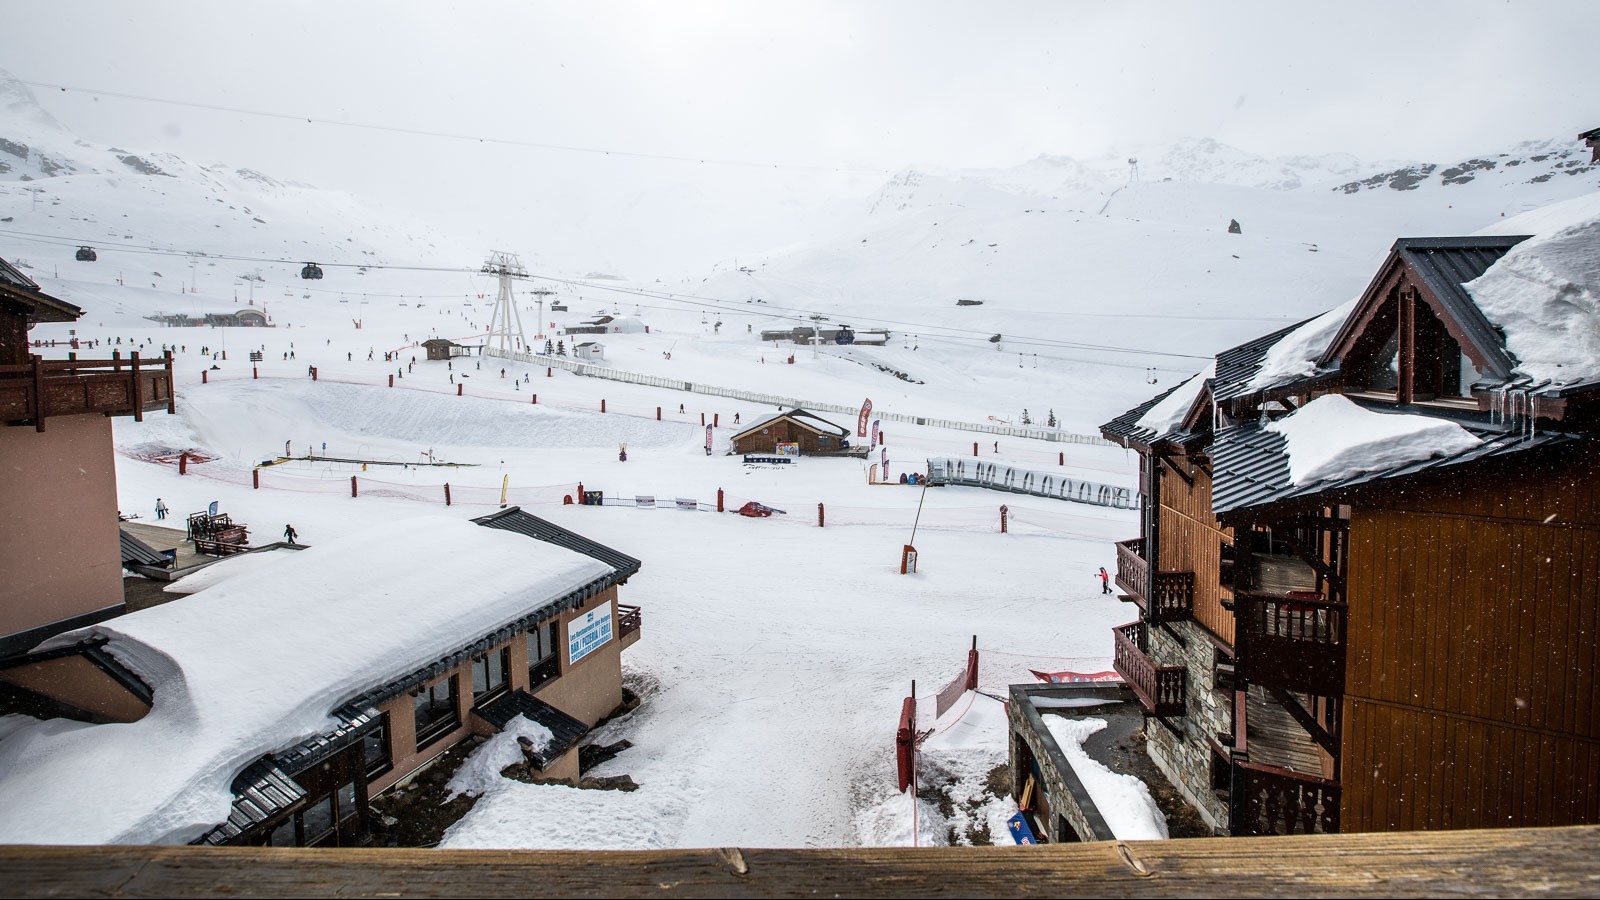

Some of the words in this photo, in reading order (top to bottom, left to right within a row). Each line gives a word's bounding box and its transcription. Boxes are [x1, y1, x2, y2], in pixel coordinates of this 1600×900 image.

[571, 641, 579, 654] BAR
[582, 630, 598, 647] PIZZERIA
[601, 622, 611, 636] GRILL
